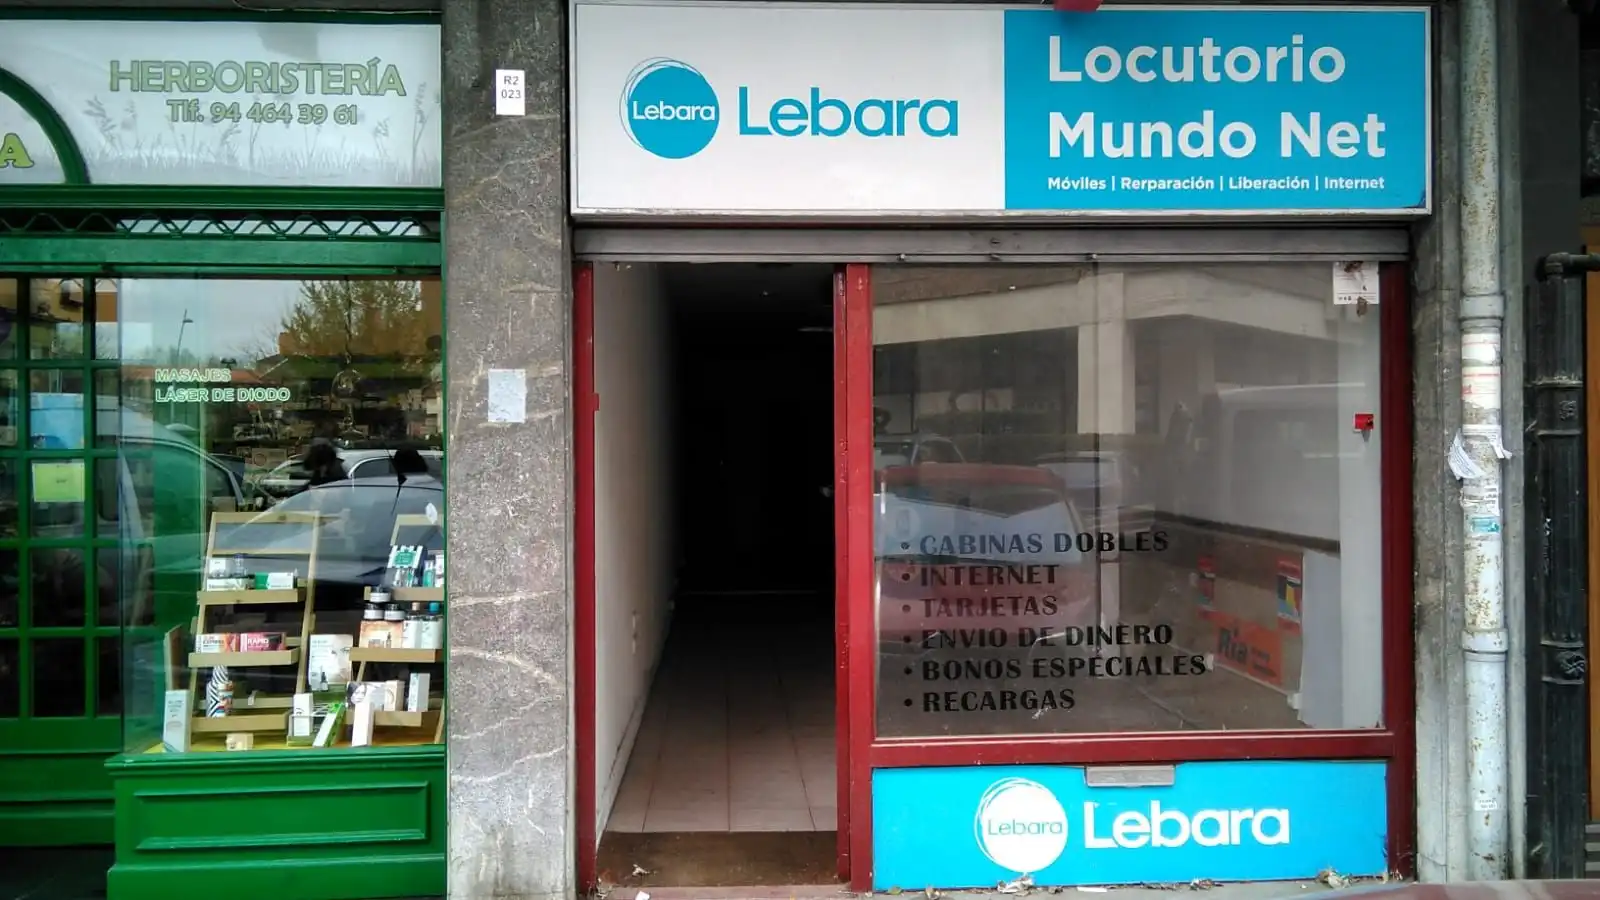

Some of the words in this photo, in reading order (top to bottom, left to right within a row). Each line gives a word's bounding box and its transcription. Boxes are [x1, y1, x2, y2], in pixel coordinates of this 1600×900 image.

[1049, 34, 1346, 83] Locutorio
[110, 57, 406, 97] HERBORISTERÍA
[503, 75, 519, 85] R2
[501, 89, 521, 99] 023
[166, 98, 204, 123] Tlf.
[210, 101, 241, 123] 94
[246, 102, 293, 124] 464
[297, 103, 328, 125] 39
[333, 104, 358, 125] 61
[632, 100, 716, 122] Lebara
[738, 86, 959, 137] Lebara
[1049, 110, 1257, 158] Mundo
[1280, 111, 1386, 158] Net
[1048, 176, 1107, 190] Móviles
[1121, 176, 1215, 192] Rerparación
[1229, 176, 1310, 190] Liberación
[1324, 176, 1385, 190] Internet
[155, 368, 231, 382] MASAJES
[156, 385, 209, 402] LÁSER
[212, 387, 235, 401] DE
[237, 387, 291, 402] DIODO
[920, 533, 1043, 555] CABINAS
[1053, 531, 1169, 552] DOBLES
[920, 564, 1060, 586] INTERNET
[921, 595, 1058, 617] TARJETAS
[921, 628, 1007, 649] ENVIO
[1018, 626, 1056, 648] DE
[1066, 624, 1173, 646] DINERO
[922, 659, 1021, 681] BONOS
[1033, 654, 1206, 678] ESPECIALES
[923, 689, 1075, 712] RECARGAS
[987, 818, 1063, 836] Lebara
[1083, 800, 1290, 849] Lebara
